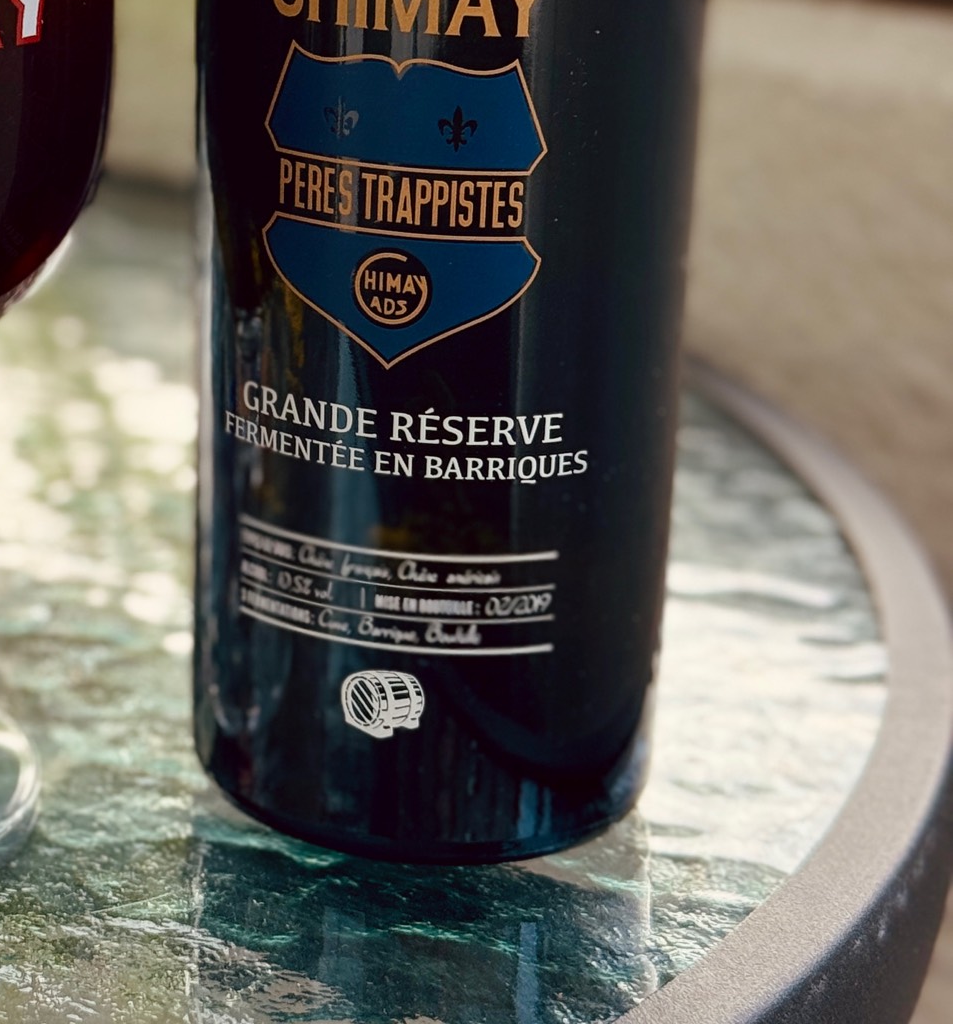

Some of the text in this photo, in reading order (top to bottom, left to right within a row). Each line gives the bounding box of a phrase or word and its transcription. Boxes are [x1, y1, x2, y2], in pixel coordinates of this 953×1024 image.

[279, 157, 524, 228] PERES TRAPPISTES
[370, 296, 407, 315] ADS
[225, 410, 588, 484] FERMENTÉE EN BARRIQUES
[242, 380, 564, 446] GRANDE RÉSERVE
